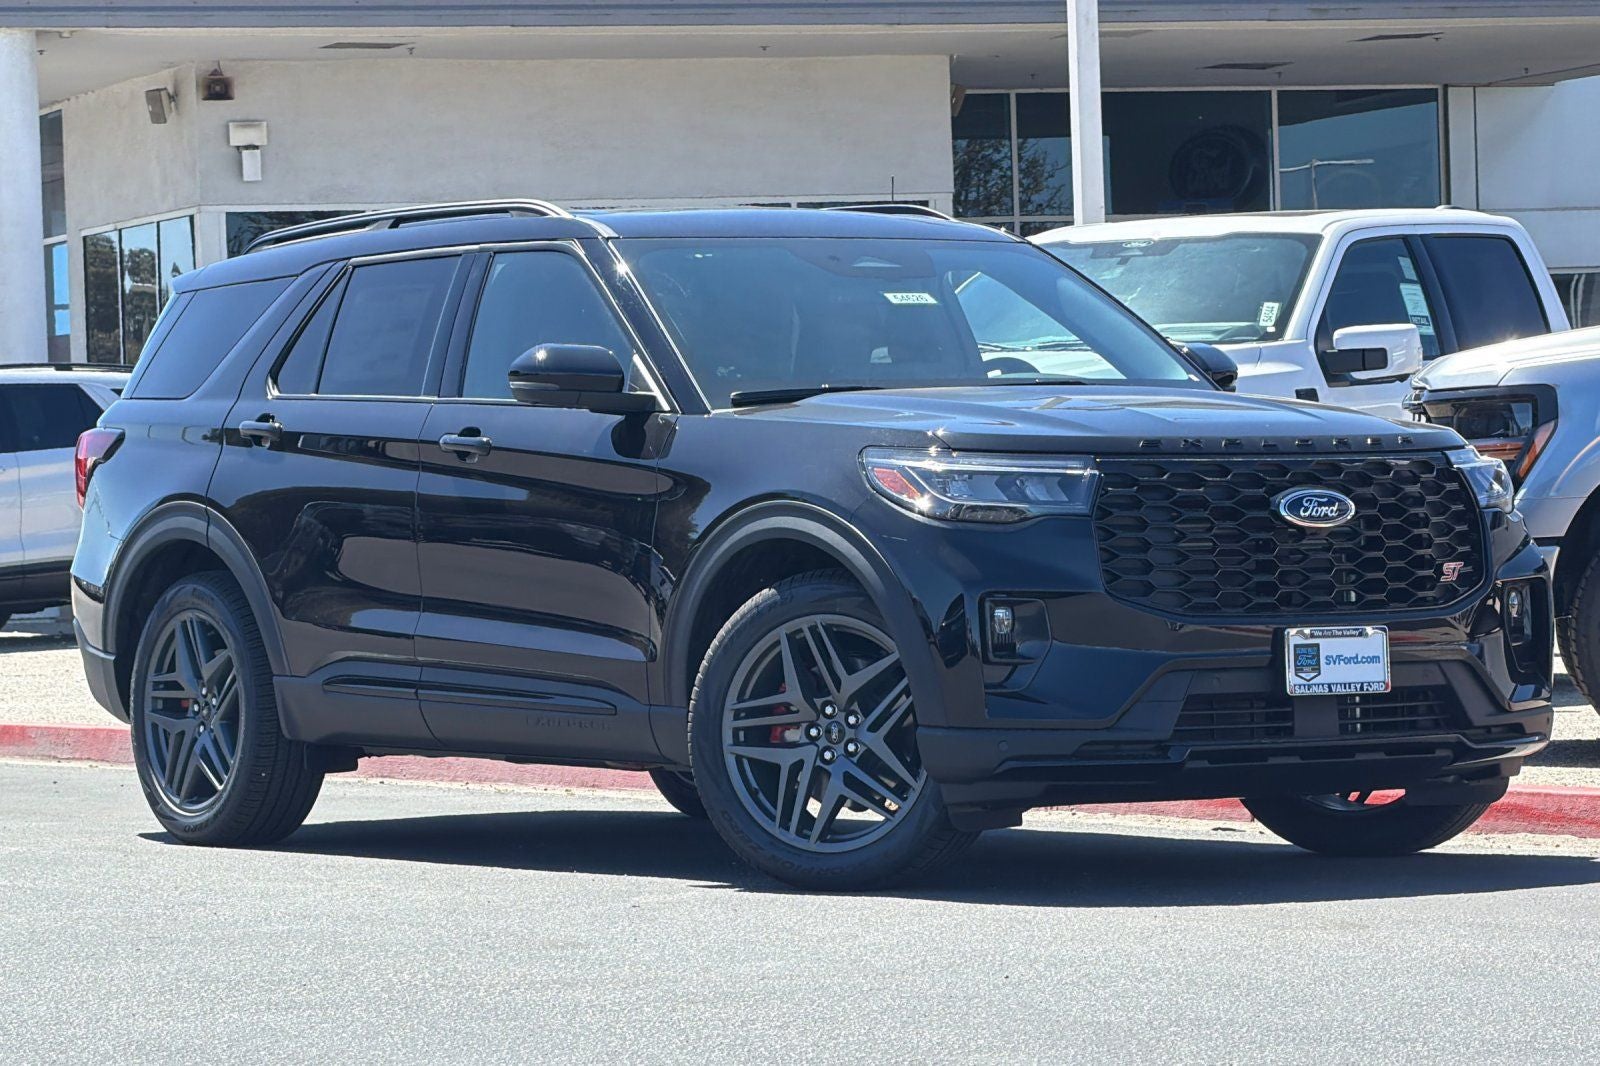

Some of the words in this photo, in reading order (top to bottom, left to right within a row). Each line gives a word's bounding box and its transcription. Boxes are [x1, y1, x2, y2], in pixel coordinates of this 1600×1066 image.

[1139, 436, 1413, 448] EXPLORER
[1300, 496, 1338, 517] Ford
[1440, 561, 1464, 582] ST
[1297, 655, 1317, 666] Ford
[1325, 653, 1380, 665] SVFord.com
[1295, 684, 1329, 694] SALINAS
[1331, 683, 1361, 692] VALLEY
[1363, 682, 1385, 691] FORD
